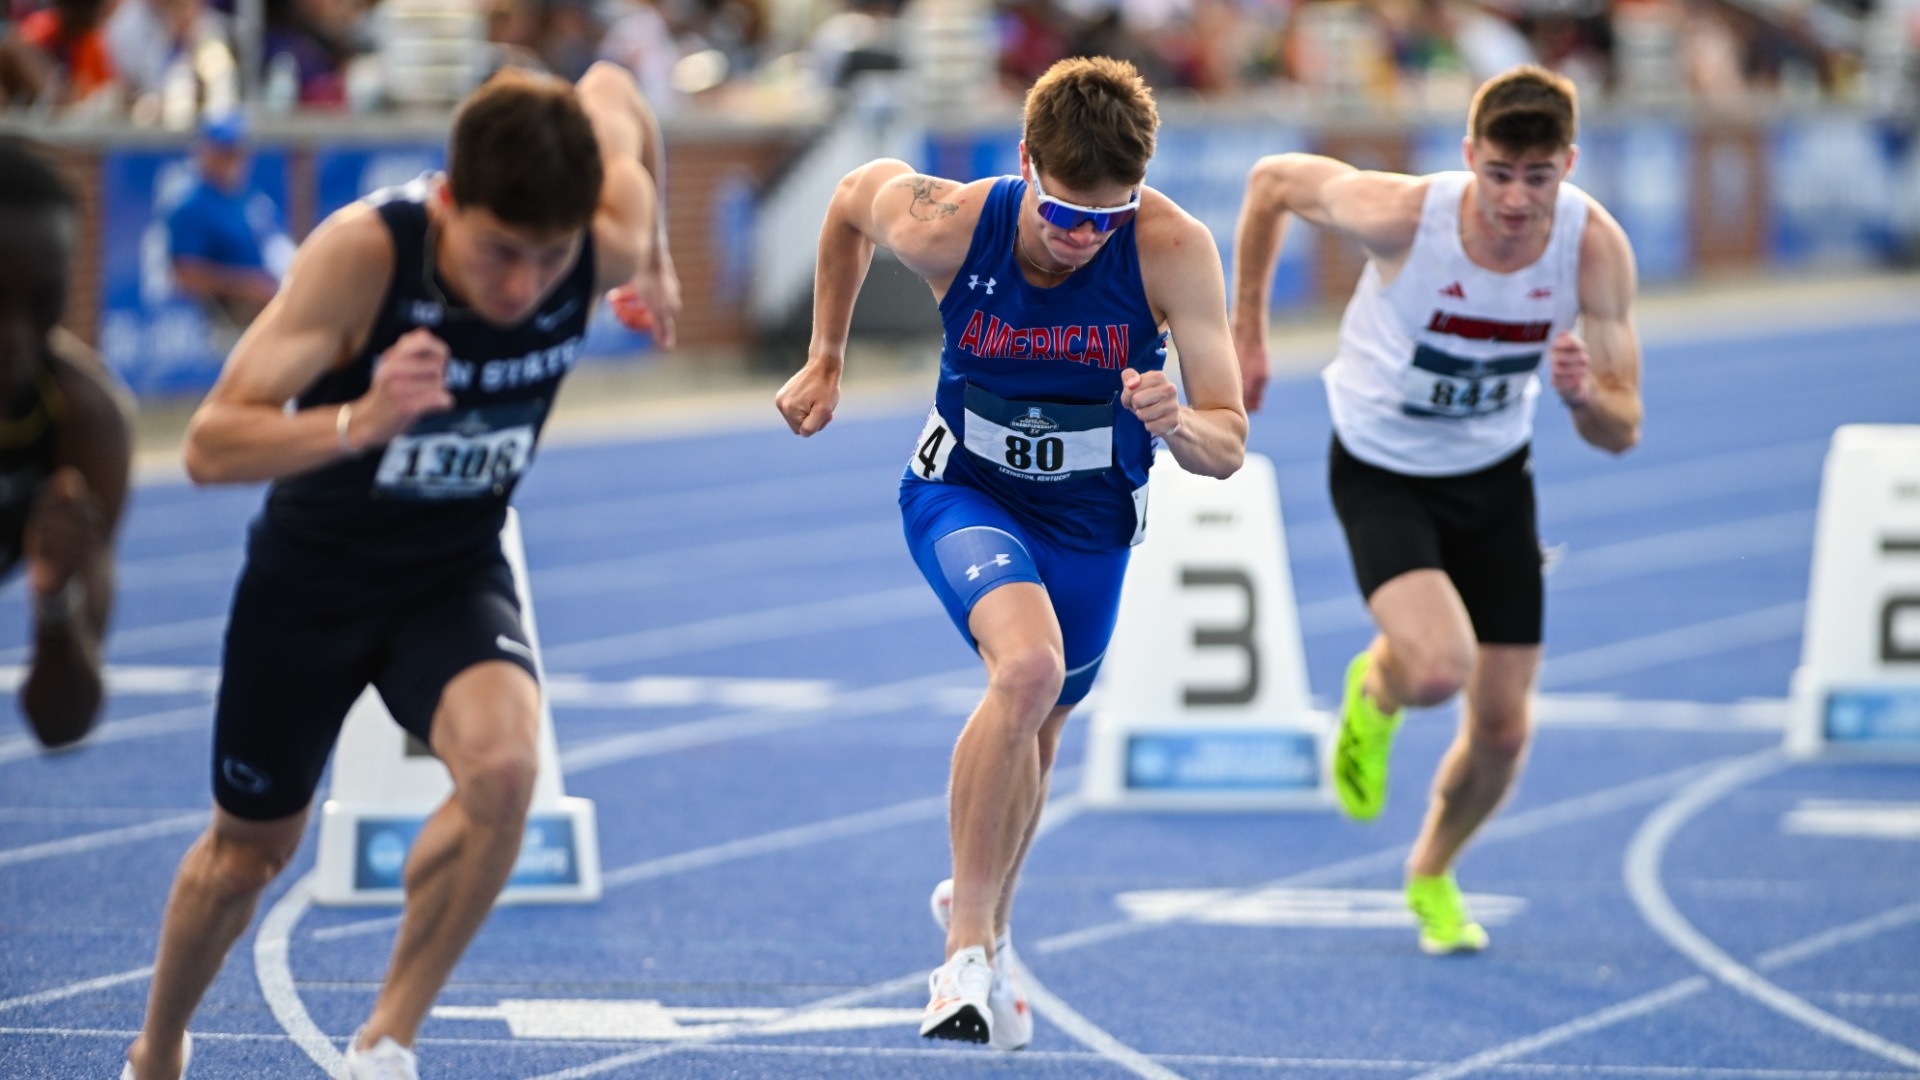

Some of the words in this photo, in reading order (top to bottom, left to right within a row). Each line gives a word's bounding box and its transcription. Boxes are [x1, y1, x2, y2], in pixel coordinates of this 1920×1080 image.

[958, 309, 1129, 370] AMERICAN
[1430, 378, 1509, 409] 844
[918, 425, 946, 479] 4
[1005, 435, 1064, 472] 80
[1036, 472, 1072, 482] KENTUCKY
[1179, 567, 1262, 708] 3
